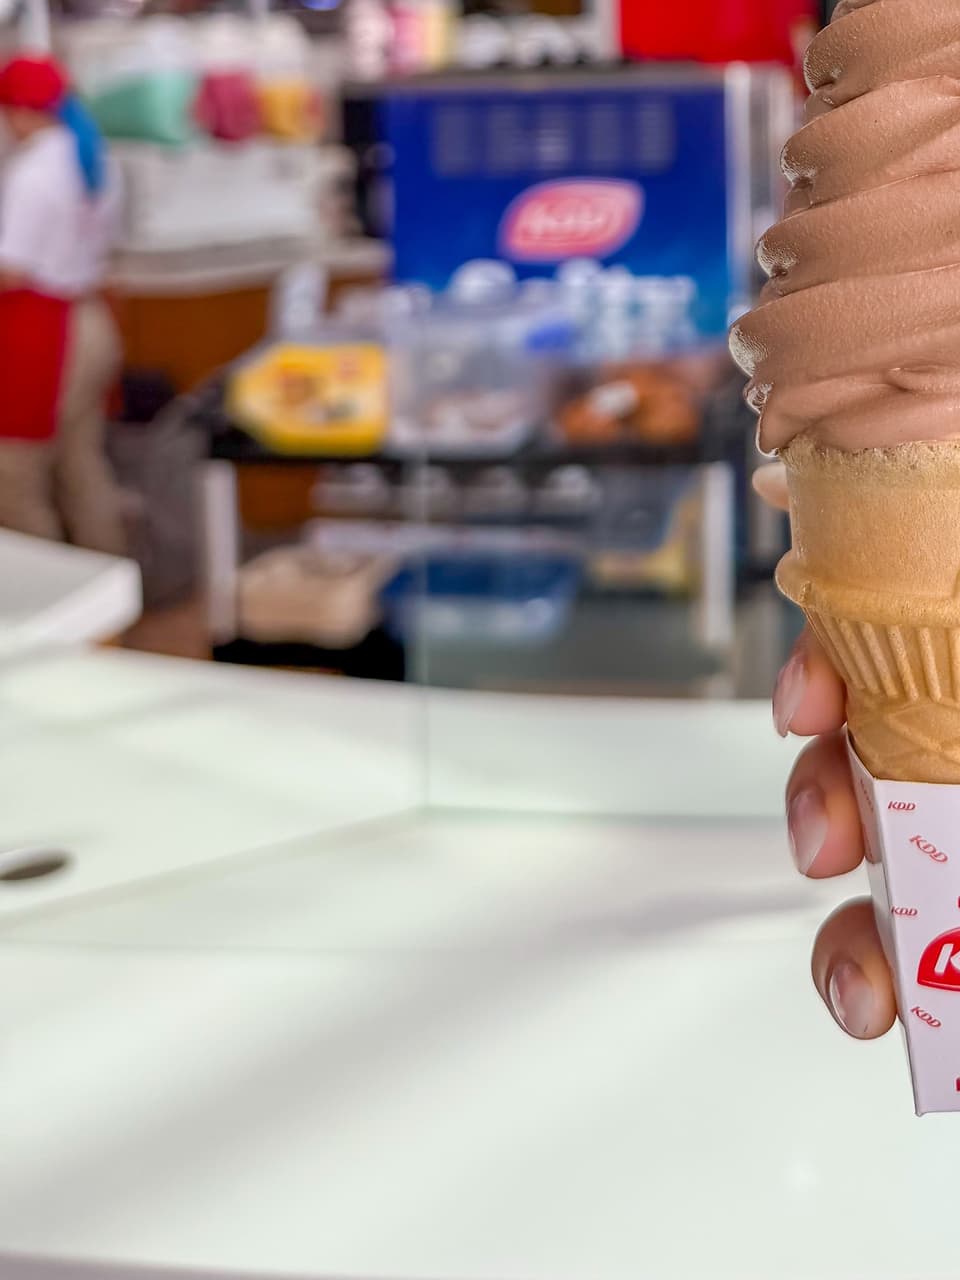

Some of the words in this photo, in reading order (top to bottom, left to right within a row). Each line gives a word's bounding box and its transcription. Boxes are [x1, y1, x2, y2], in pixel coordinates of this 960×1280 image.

[887, 800, 917, 812] KDD
[909, 835, 949, 864] KDD
[910, 1006, 942, 1029] KDD
